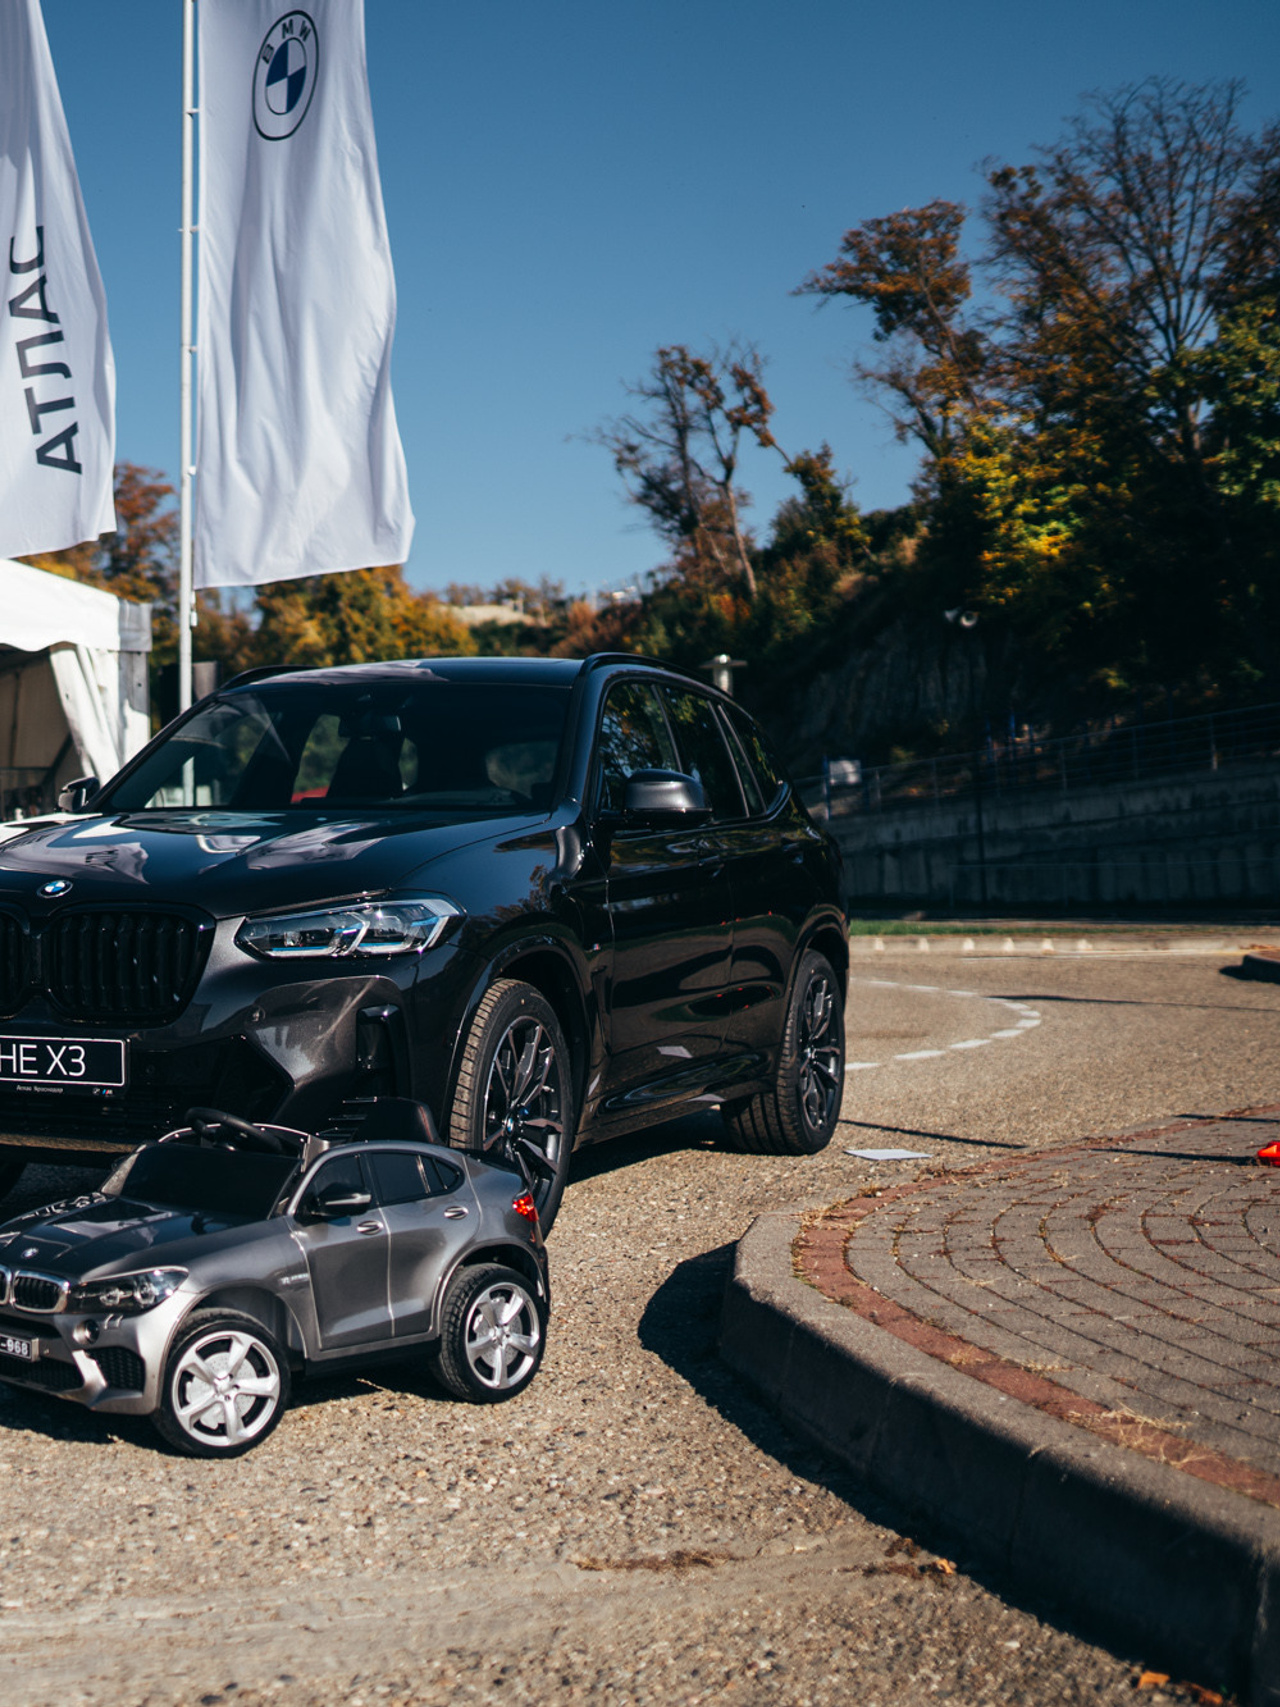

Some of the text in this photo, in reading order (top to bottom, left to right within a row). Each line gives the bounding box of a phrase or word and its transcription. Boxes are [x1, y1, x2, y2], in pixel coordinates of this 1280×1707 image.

[261, 18, 311, 64] BMW
[8, 225, 82, 475] АТЛАС
[46, 1044, 86, 1077] X3
